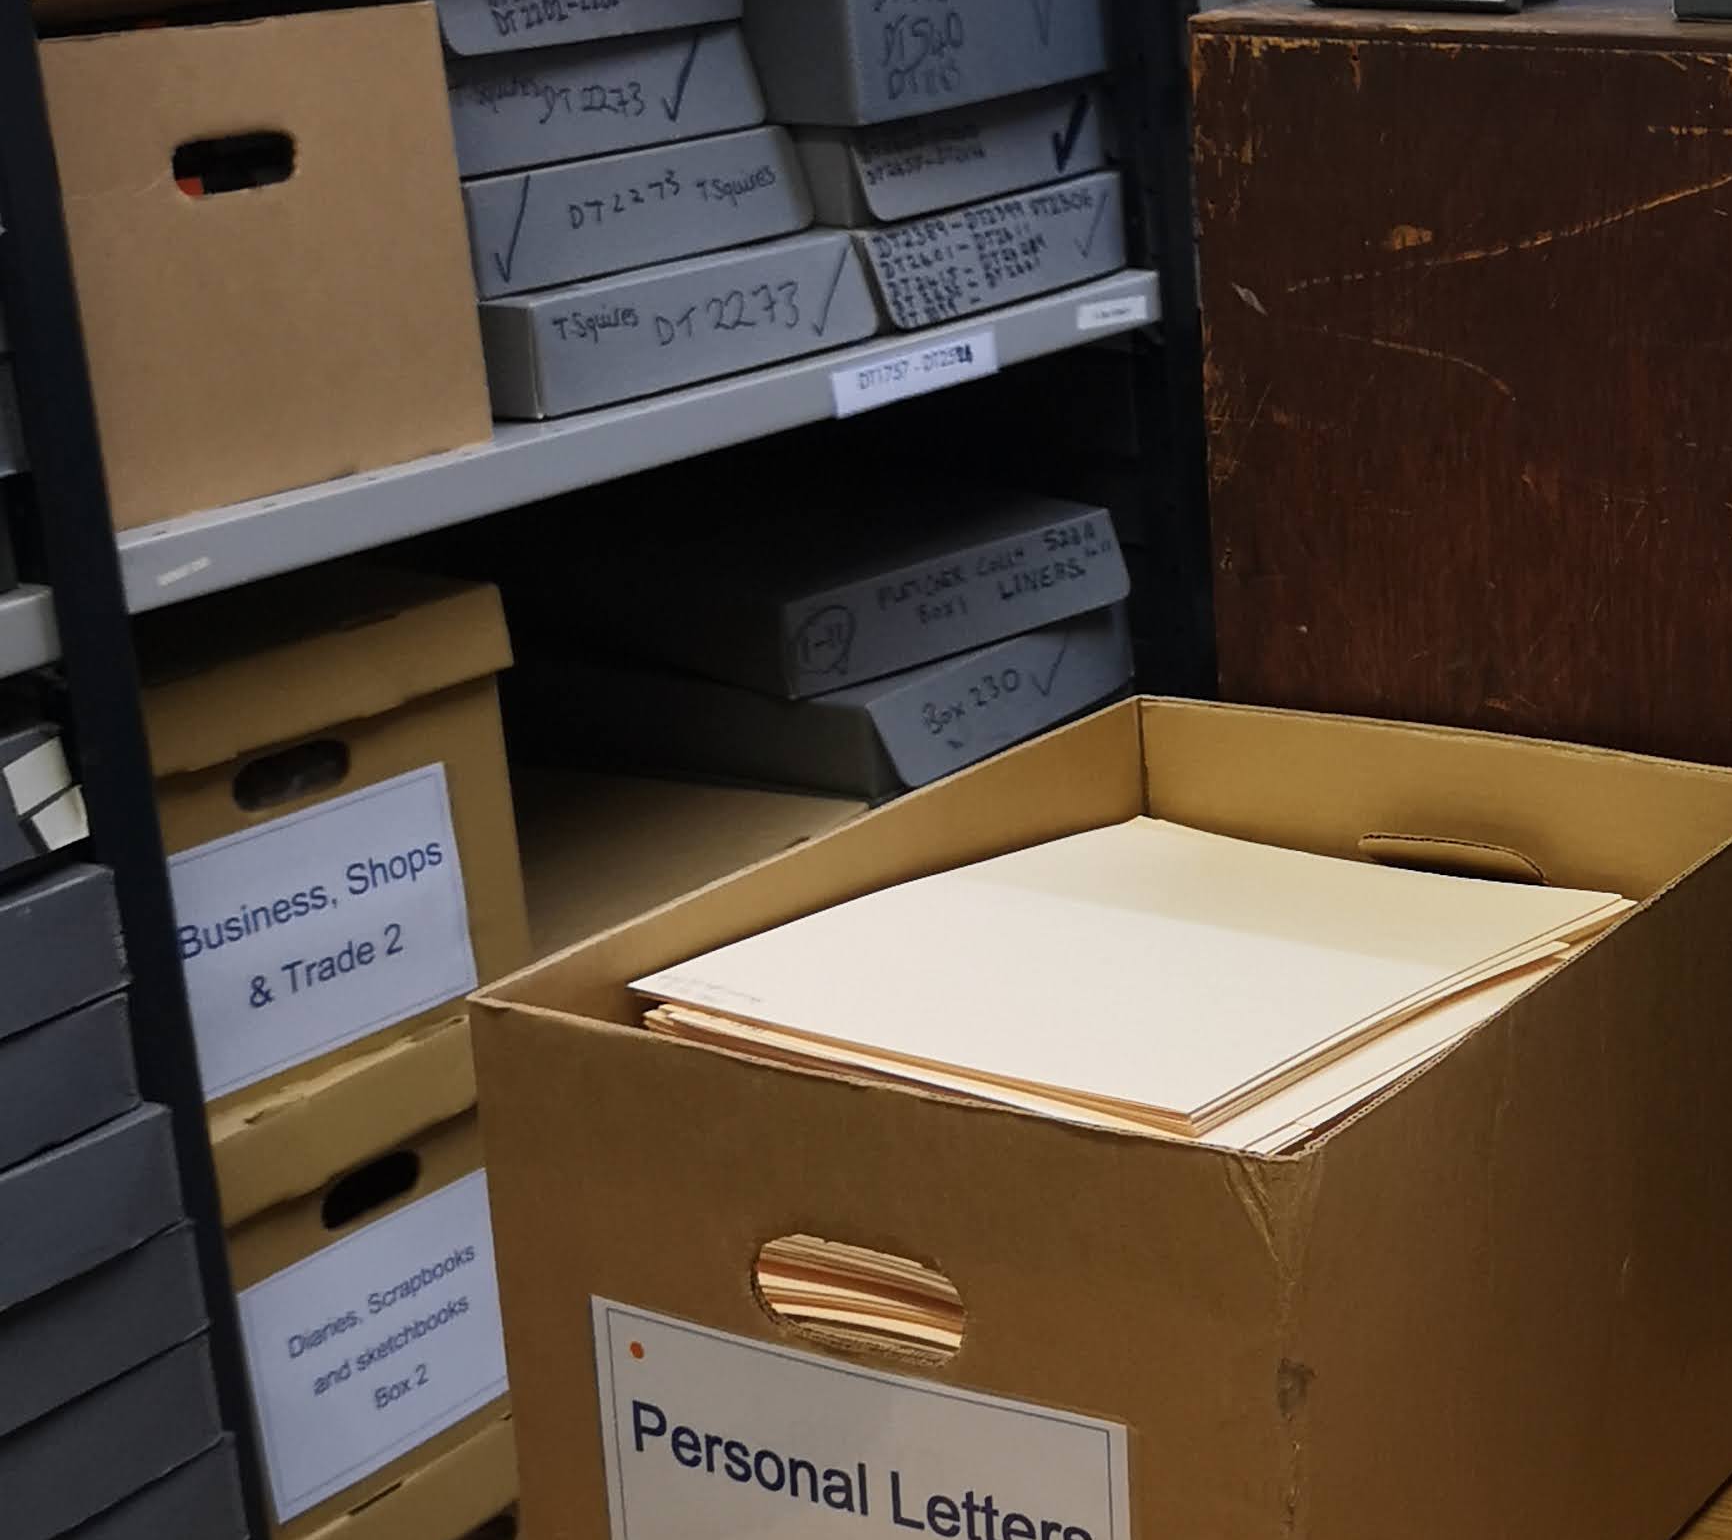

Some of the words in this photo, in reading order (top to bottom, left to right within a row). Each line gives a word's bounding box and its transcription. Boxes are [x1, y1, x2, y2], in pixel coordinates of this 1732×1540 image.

[176, 884, 339, 961] Business,
[346, 841, 443, 896] Shops
[249, 974, 274, 1008] &
[281, 939, 377, 995] Trade
[383, 922, 405, 956] 2
[287, 1309, 365, 1359] Diaries,
[367, 1245, 476, 1315] Scrapbooks
[313, 1360, 352, 1397] and
[355, 1295, 470, 1373] sketchbooks
[373, 1375, 412, 1410] Box
[414, 1362, 430, 1386] 2
[631, 1400, 870, 1517] Personal
